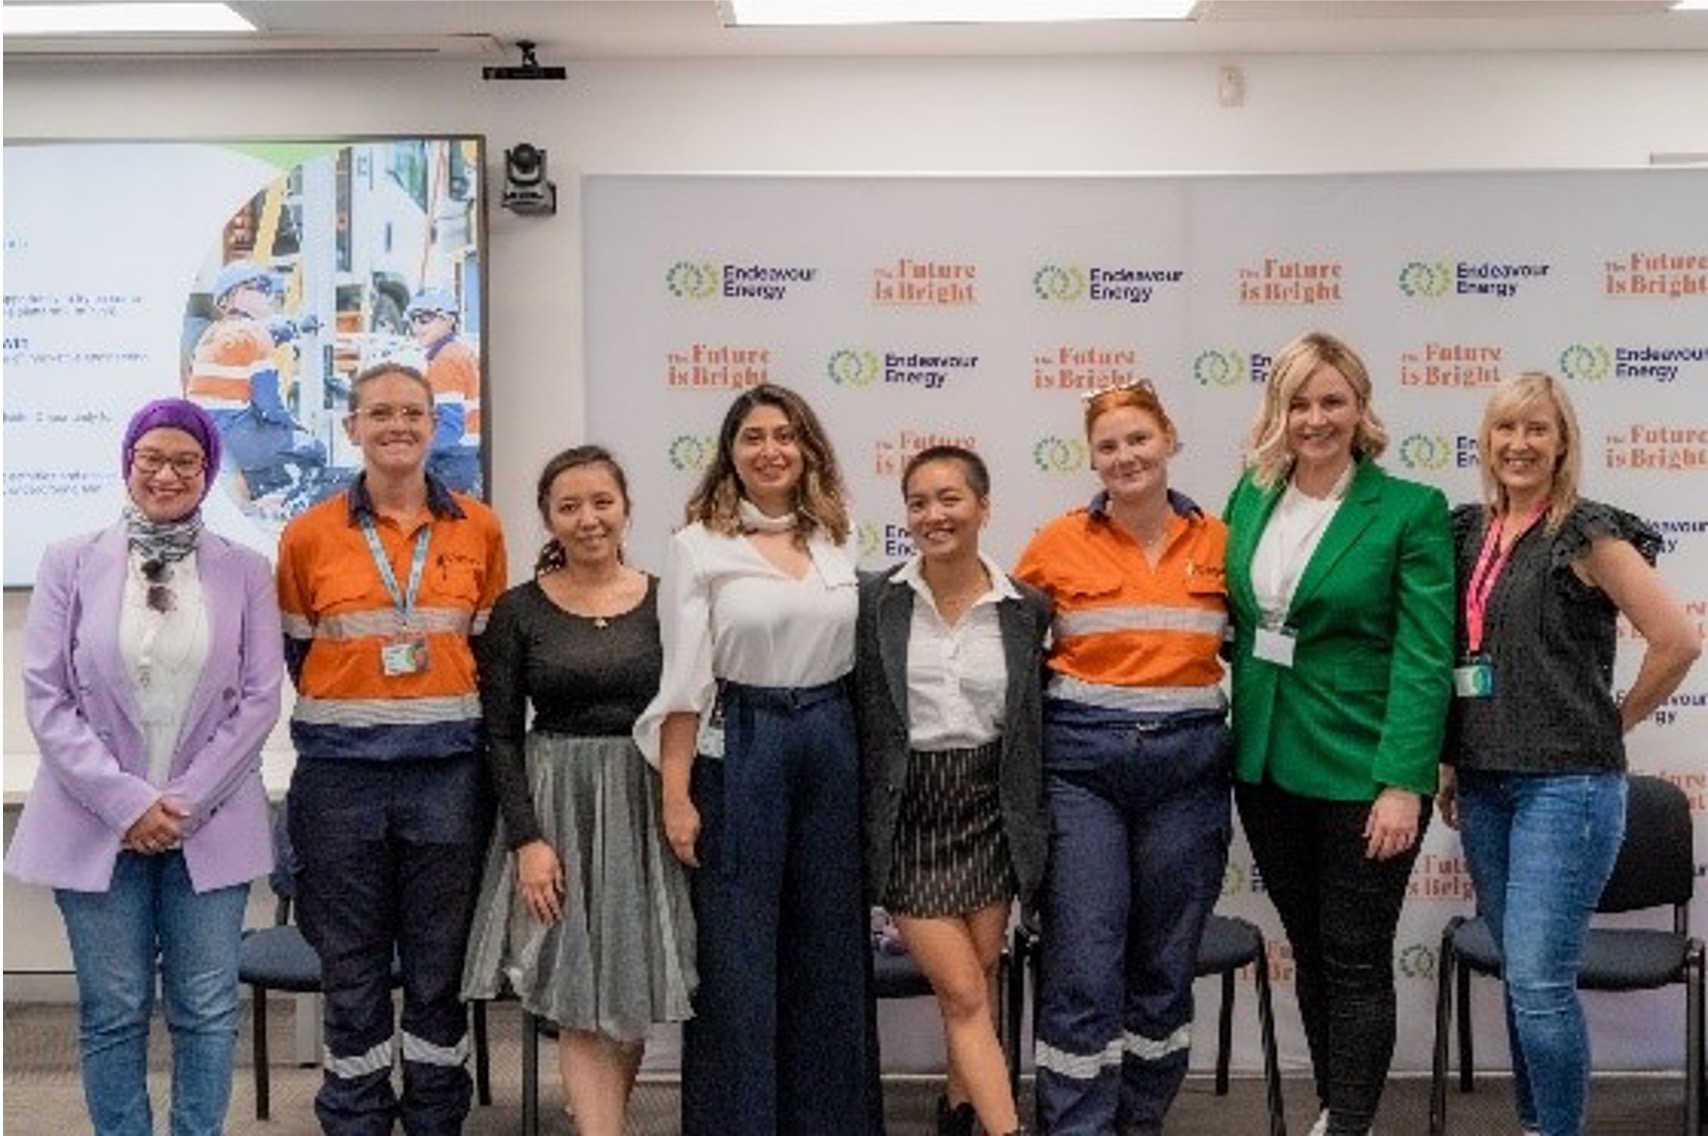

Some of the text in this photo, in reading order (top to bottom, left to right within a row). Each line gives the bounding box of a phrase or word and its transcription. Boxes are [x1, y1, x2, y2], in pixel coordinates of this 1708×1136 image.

[899, 258, 976, 279] Future
[1264, 258, 1343, 279] Future
[1457, 262, 1550, 279] Endeavour
[1631, 252, 1708, 271] Future
[723, 264, 818, 281] Endeavour
[1090, 268, 1183, 282] Endeavour
[723, 280, 786, 300] Energy
[875, 280, 974, 304] is Bright
[1090, 283, 1152, 303] Energy
[1241, 280, 1343, 304] is Bright
[1457, 281, 1520, 298] Energy
[1606, 274, 1708, 297] is Bright
[692, 344, 769, 364] Future
[885, 353, 979, 367] Endeavour
[1059, 346, 1134, 365] Future
[1425, 343, 1502, 362] Future
[669, 366, 769, 390] is Bright
[885, 369, 947, 389] Energy
[1034, 369, 1055, 389] is
[1401, 366, 1502, 389] is Bright
[1615, 363, 1679, 383] Energy
[1631, 425, 1708, 443] Future
[1606, 447, 1708, 472] is Bright
